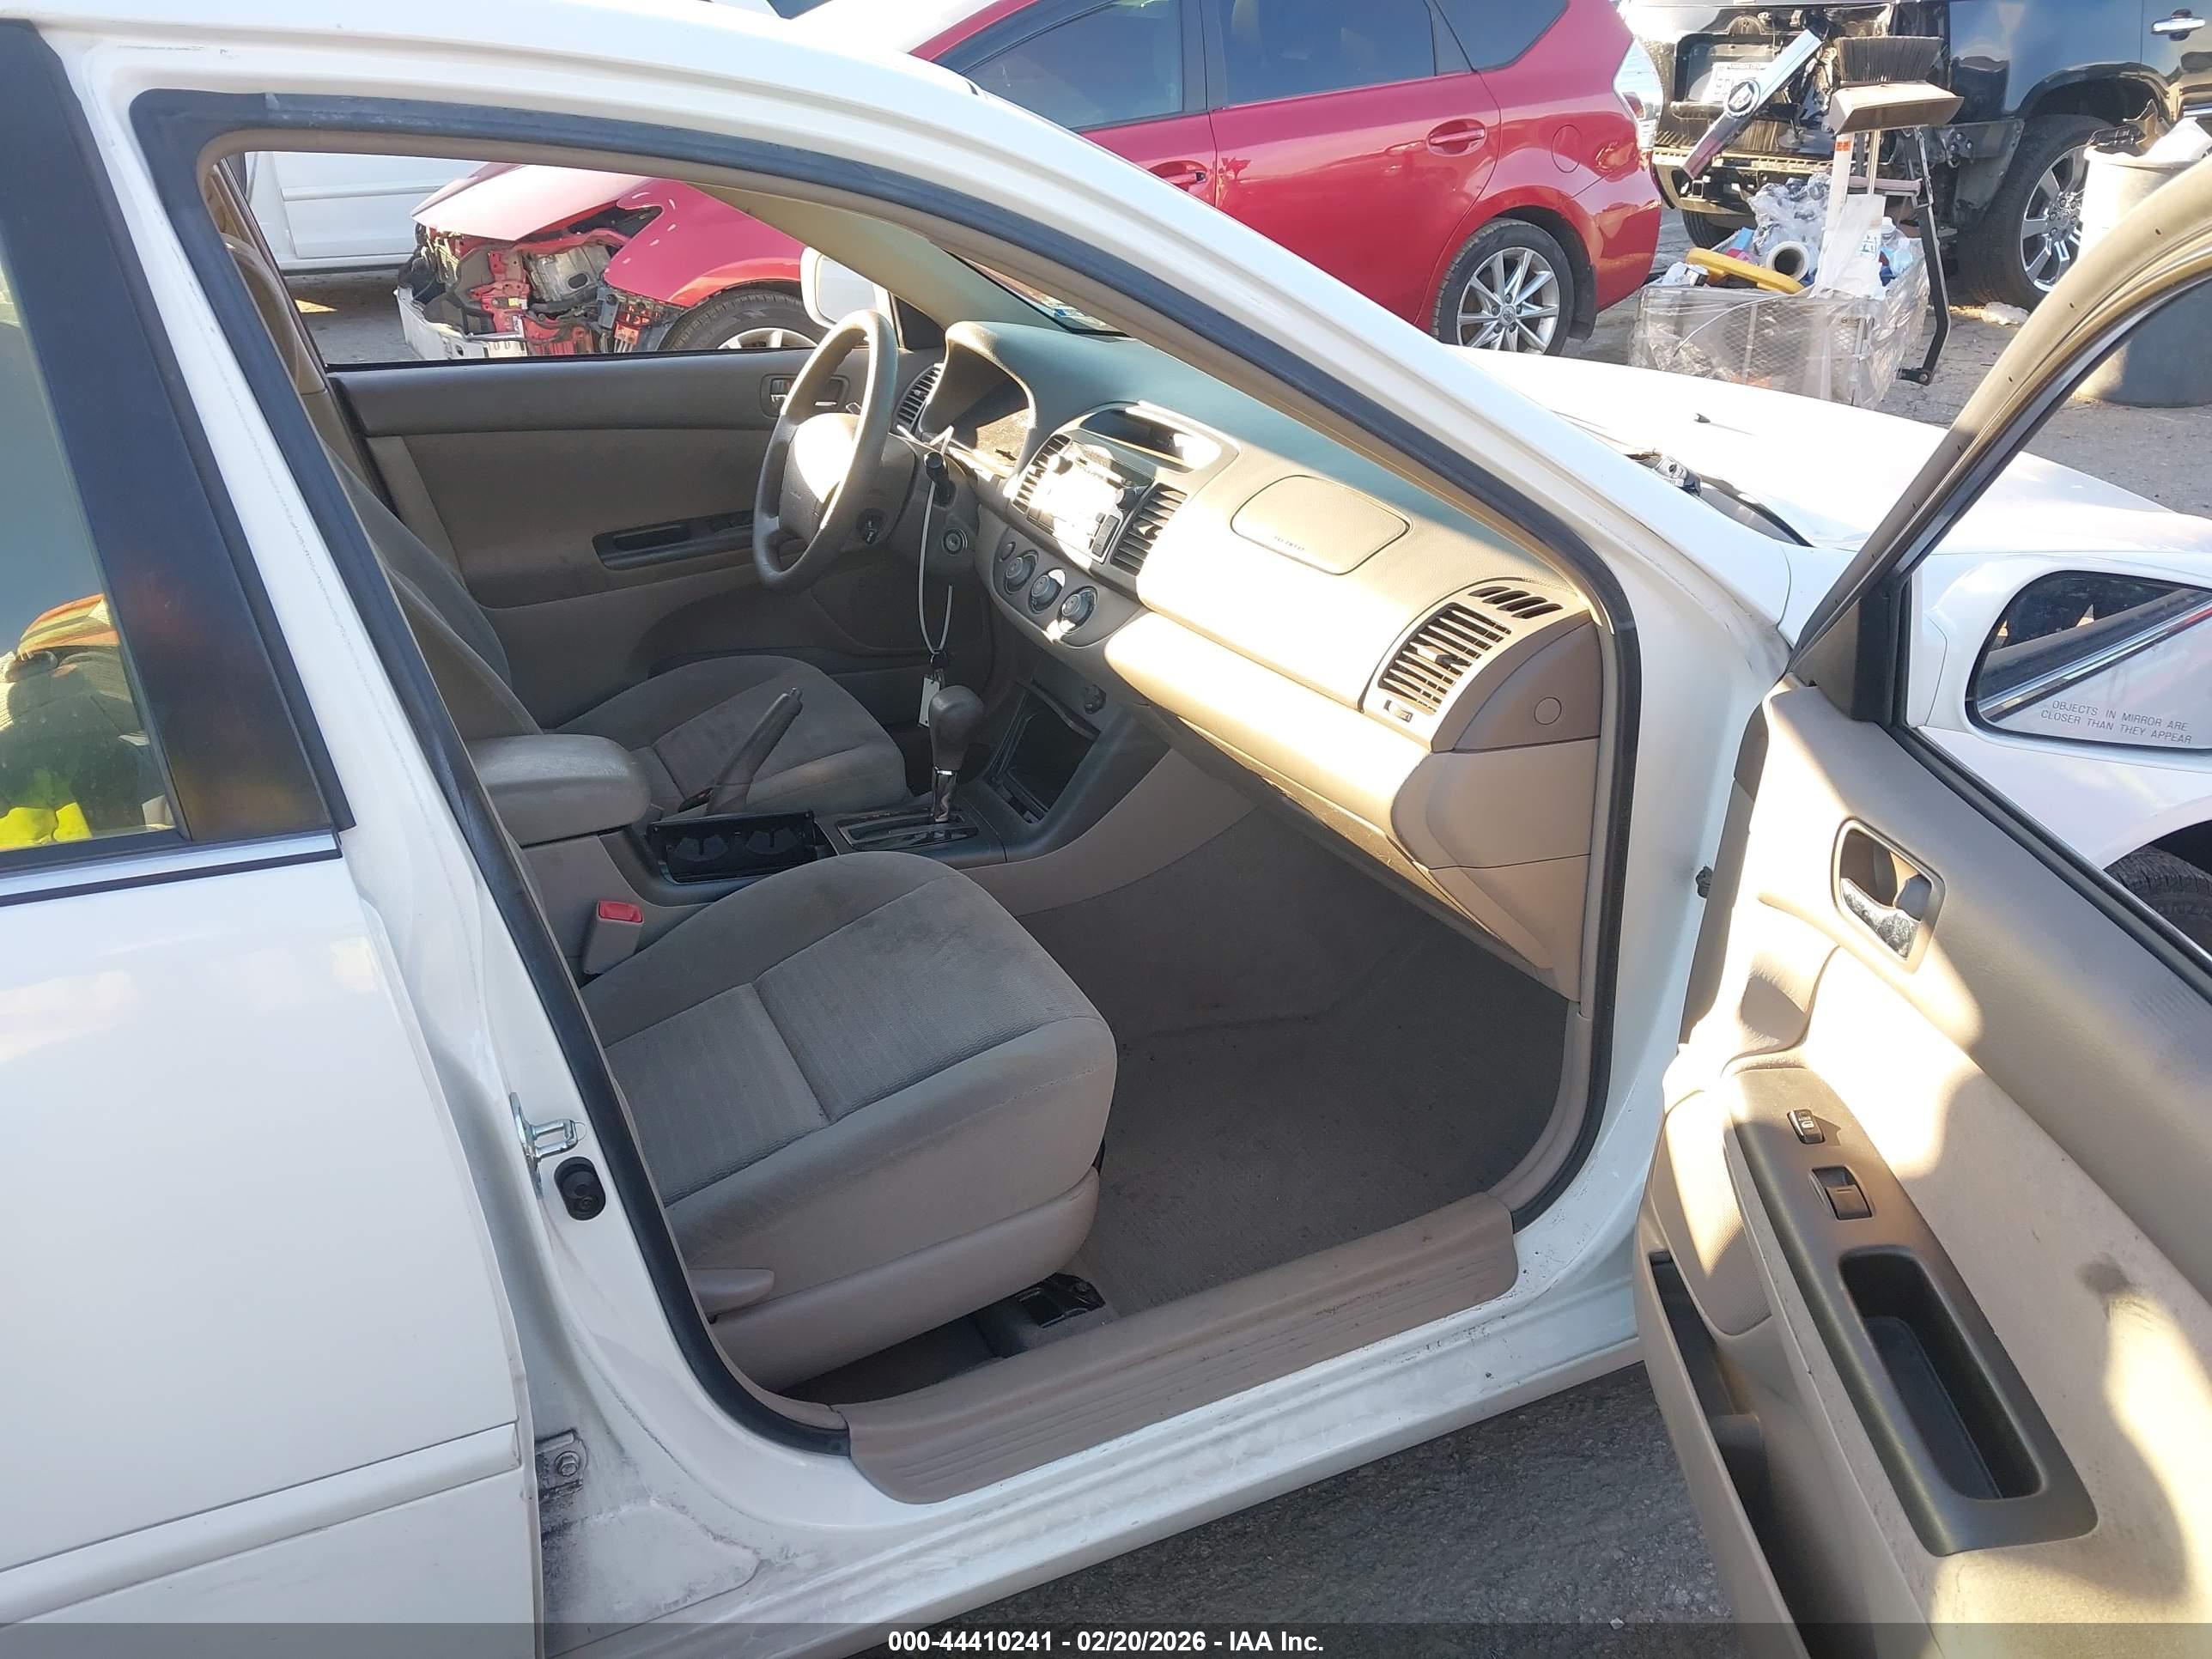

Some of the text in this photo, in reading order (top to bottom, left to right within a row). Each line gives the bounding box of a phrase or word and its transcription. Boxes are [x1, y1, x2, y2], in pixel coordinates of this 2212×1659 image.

[2040, 709, 2192, 744] CLOSER THAN THEY APPEAR
[2052, 700, 2189, 732] OBJECTS IN MIRROR ARE
